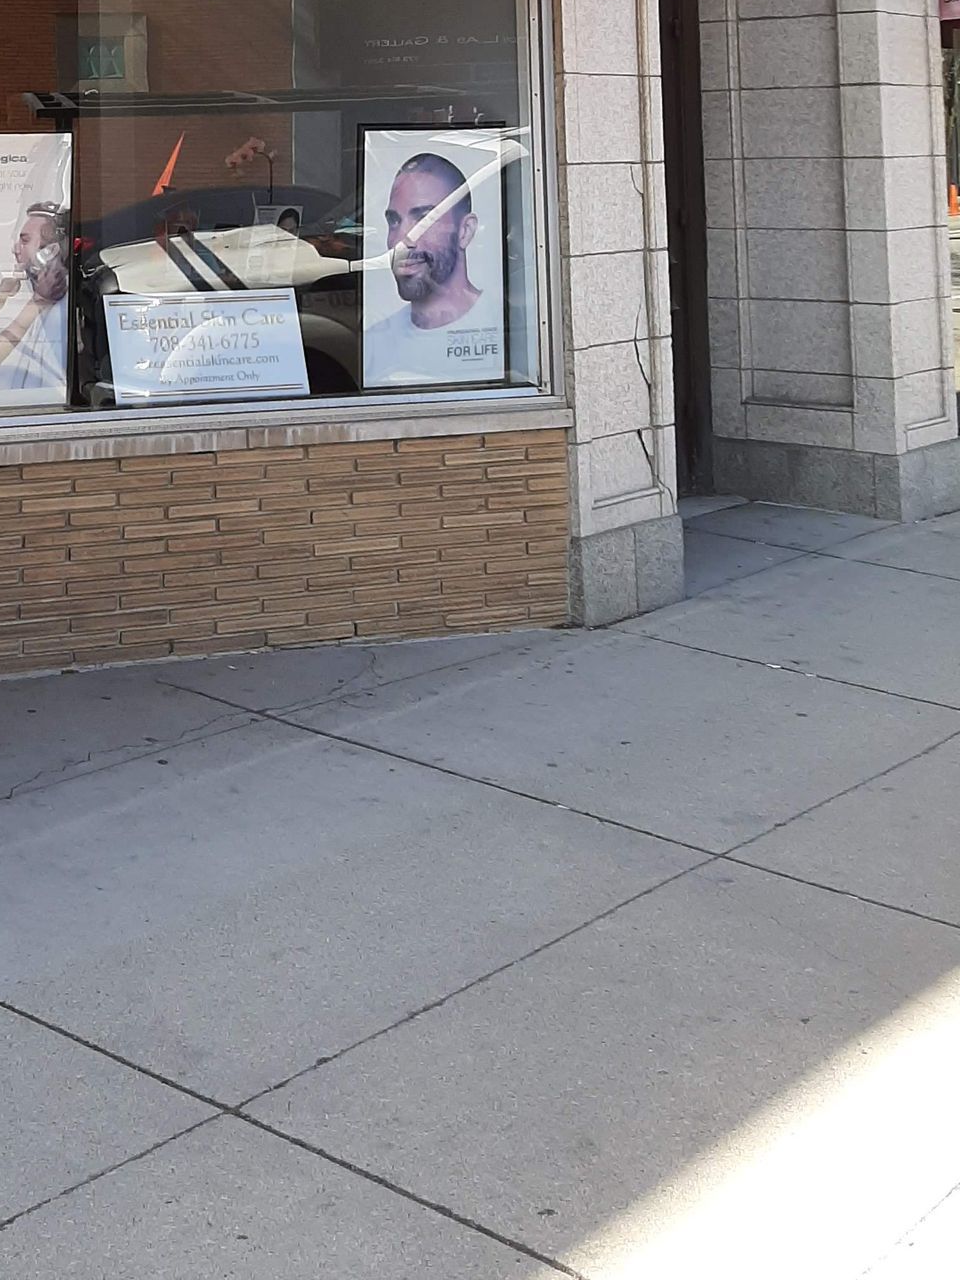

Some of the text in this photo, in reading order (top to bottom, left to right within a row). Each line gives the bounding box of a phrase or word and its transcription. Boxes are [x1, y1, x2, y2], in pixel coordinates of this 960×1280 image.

[241, 307, 286, 326] Care
[150, 332, 260, 352] 708-341-6775
[447, 343, 499, 358] FOR LIFE
[236, 369, 260, 382] Only
